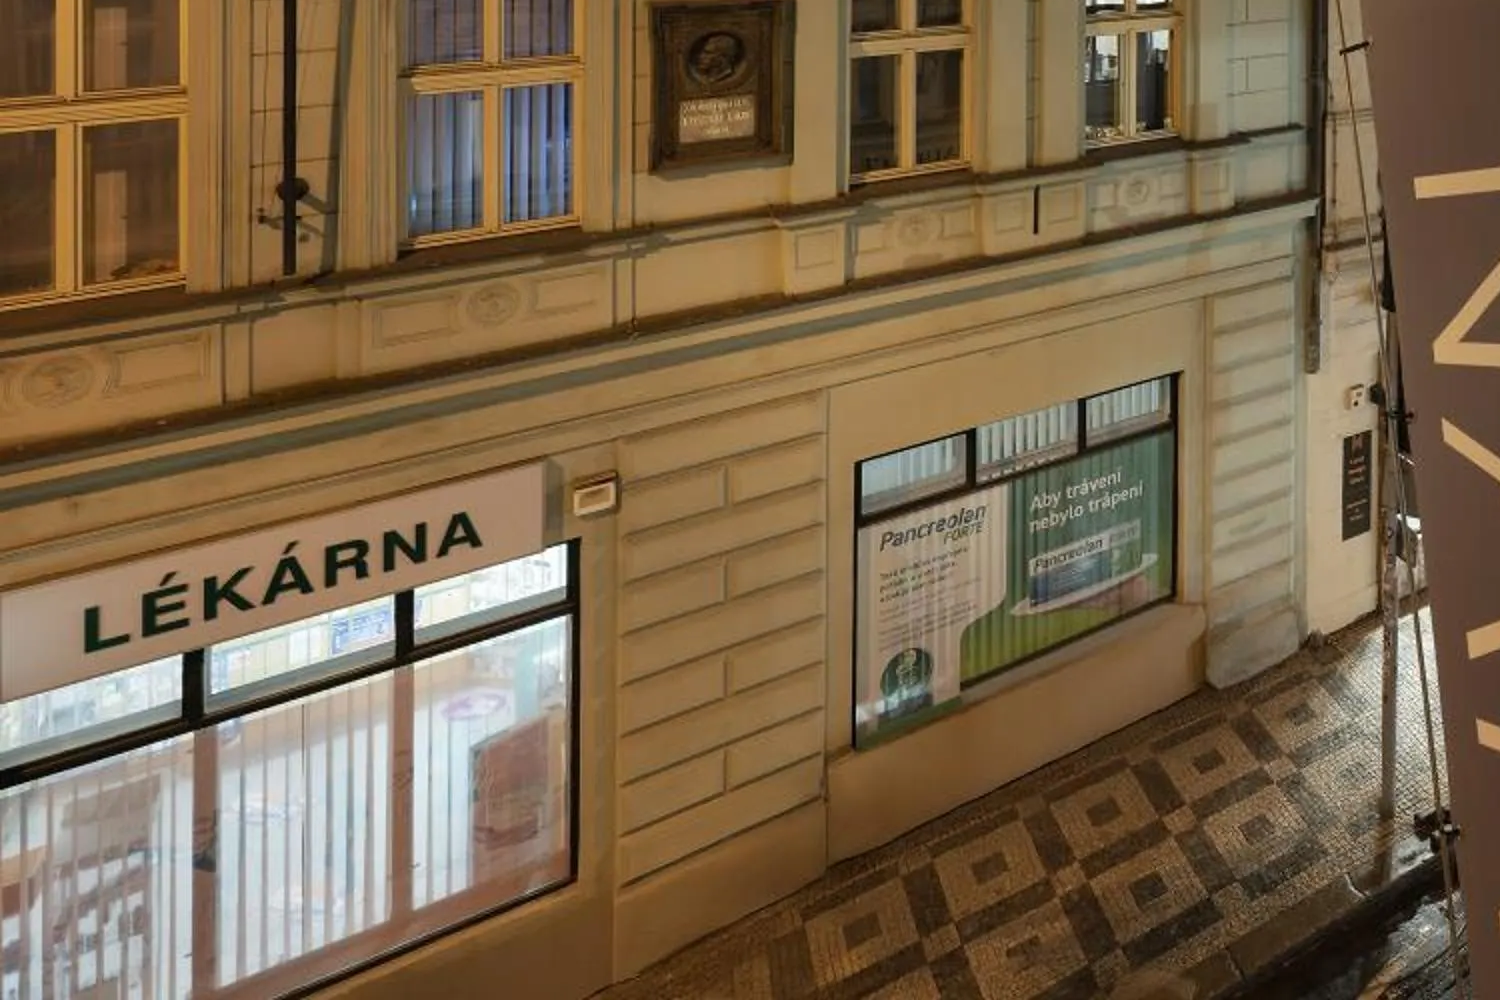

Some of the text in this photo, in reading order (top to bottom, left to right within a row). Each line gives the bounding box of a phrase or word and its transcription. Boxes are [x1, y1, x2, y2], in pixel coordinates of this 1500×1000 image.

[1029, 504, 1084, 534] nebylo
[1088, 480, 1144, 512] trápení
[1030, 466, 1122, 513] Aby trávení
[880, 505, 987, 552] Pancreolan
[943, 520, 984, 544] FORTE
[84, 511, 482, 654] LÉKÁRNA
